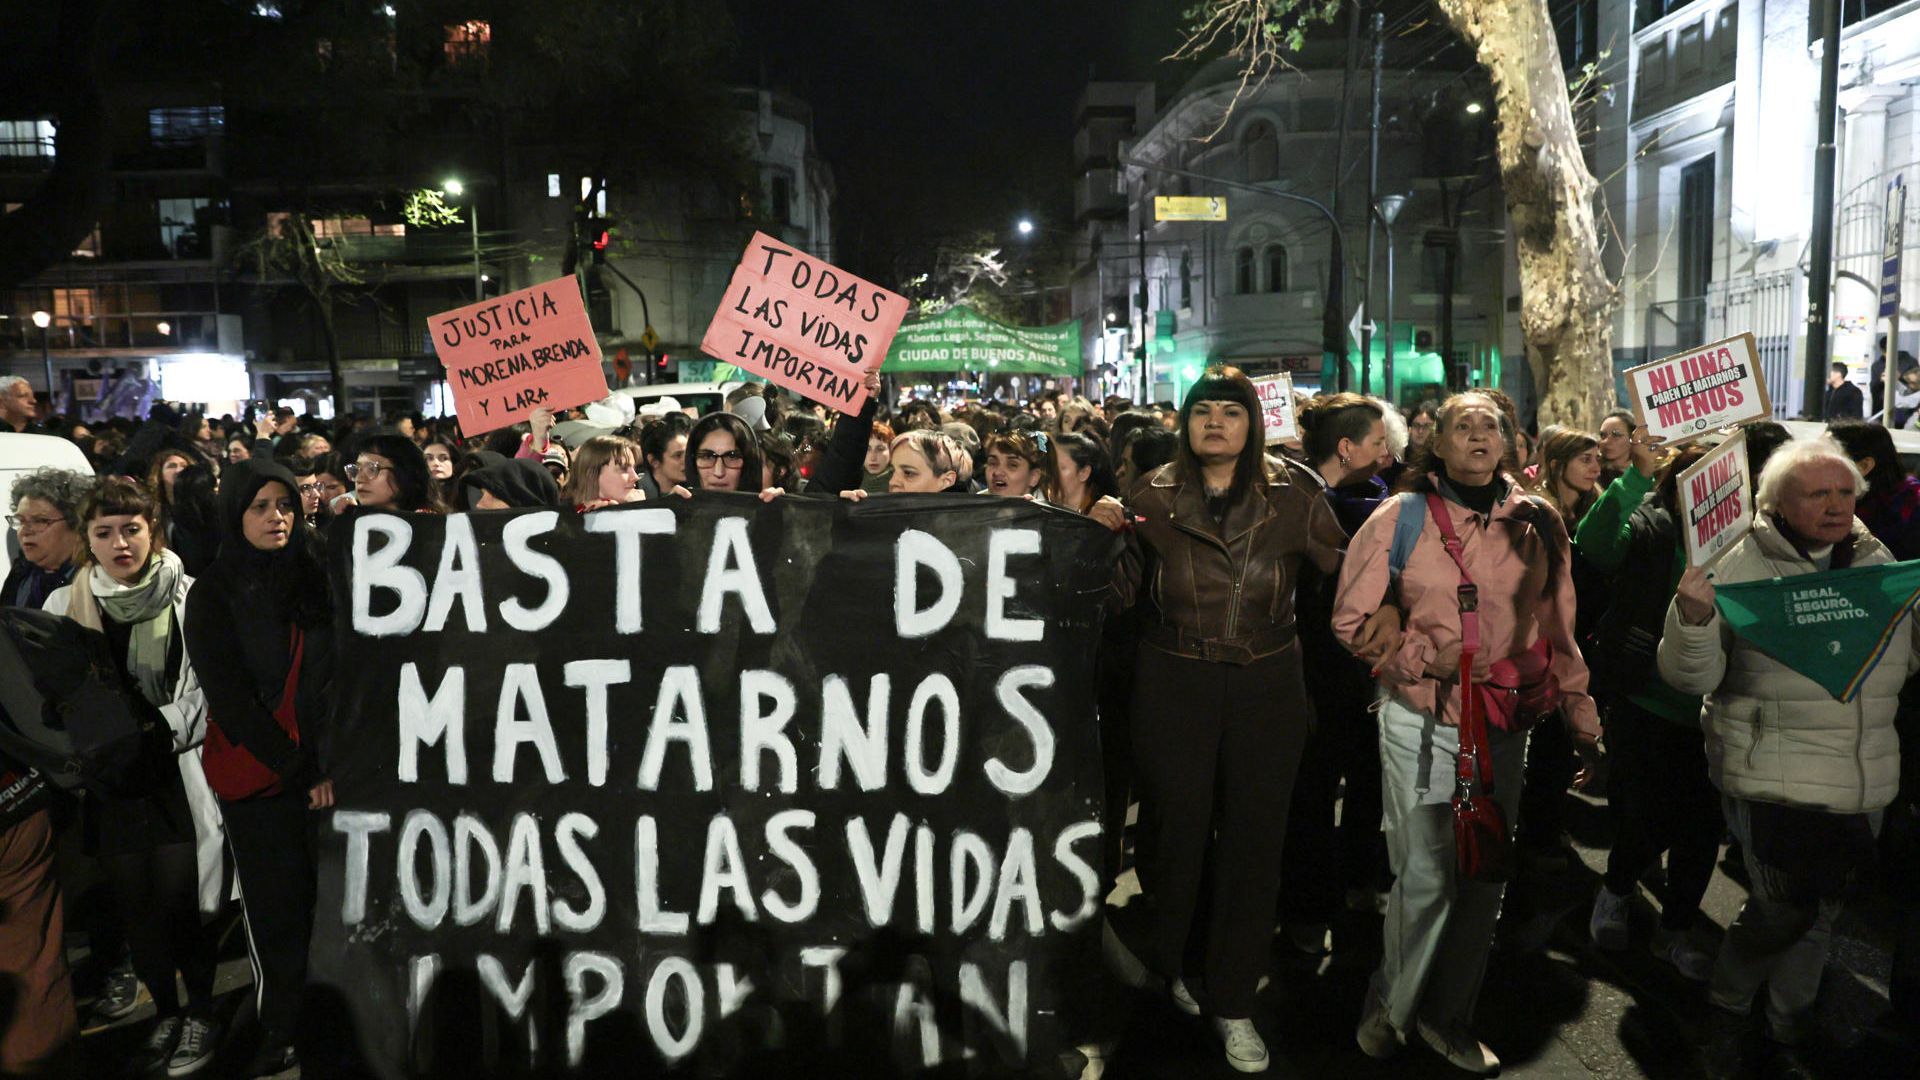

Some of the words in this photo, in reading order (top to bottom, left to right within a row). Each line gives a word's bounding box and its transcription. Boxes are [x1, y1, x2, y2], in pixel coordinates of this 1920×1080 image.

[735, 285, 788, 328] LAS
[761, 245, 886, 322] TODAS
[490, 332, 531, 350] PARA
[899, 349, 949, 361] CIUDAD
[953, 348, 968, 360] DE
[971, 347, 1025, 361] BUENOS
[735, 330, 859, 403] IMPORTAN
[1648, 364, 1677, 394] NI
[1680, 347, 1735, 383] UNA
[1652, 387, 1681, 407] PAREN
[1681, 383, 1694, 397] DE
[1694, 366, 1741, 392] MATARNOS
[479, 399, 489, 416] Y
[504, 388, 549, 412] LARA
[1657, 380, 1744, 429] MENOS
[1692, 472, 1708, 508] NI
[1708, 451, 1738, 493] UNA
[1697, 490, 1742, 548] MENOS
[353, 508, 777, 637] BASTA
[894, 527, 1046, 641] DE
[1793, 587, 1840, 601] LEGAL,
[1794, 597, 1853, 613] SEGURO,
[1796, 608, 1869, 625] GRATUITO.
[398, 659, 1056, 794] MATARNOS
[333, 809, 605, 934] TODAS
[635, 809, 821, 934] LAS
[845, 811, 1102, 941] VIDAS
